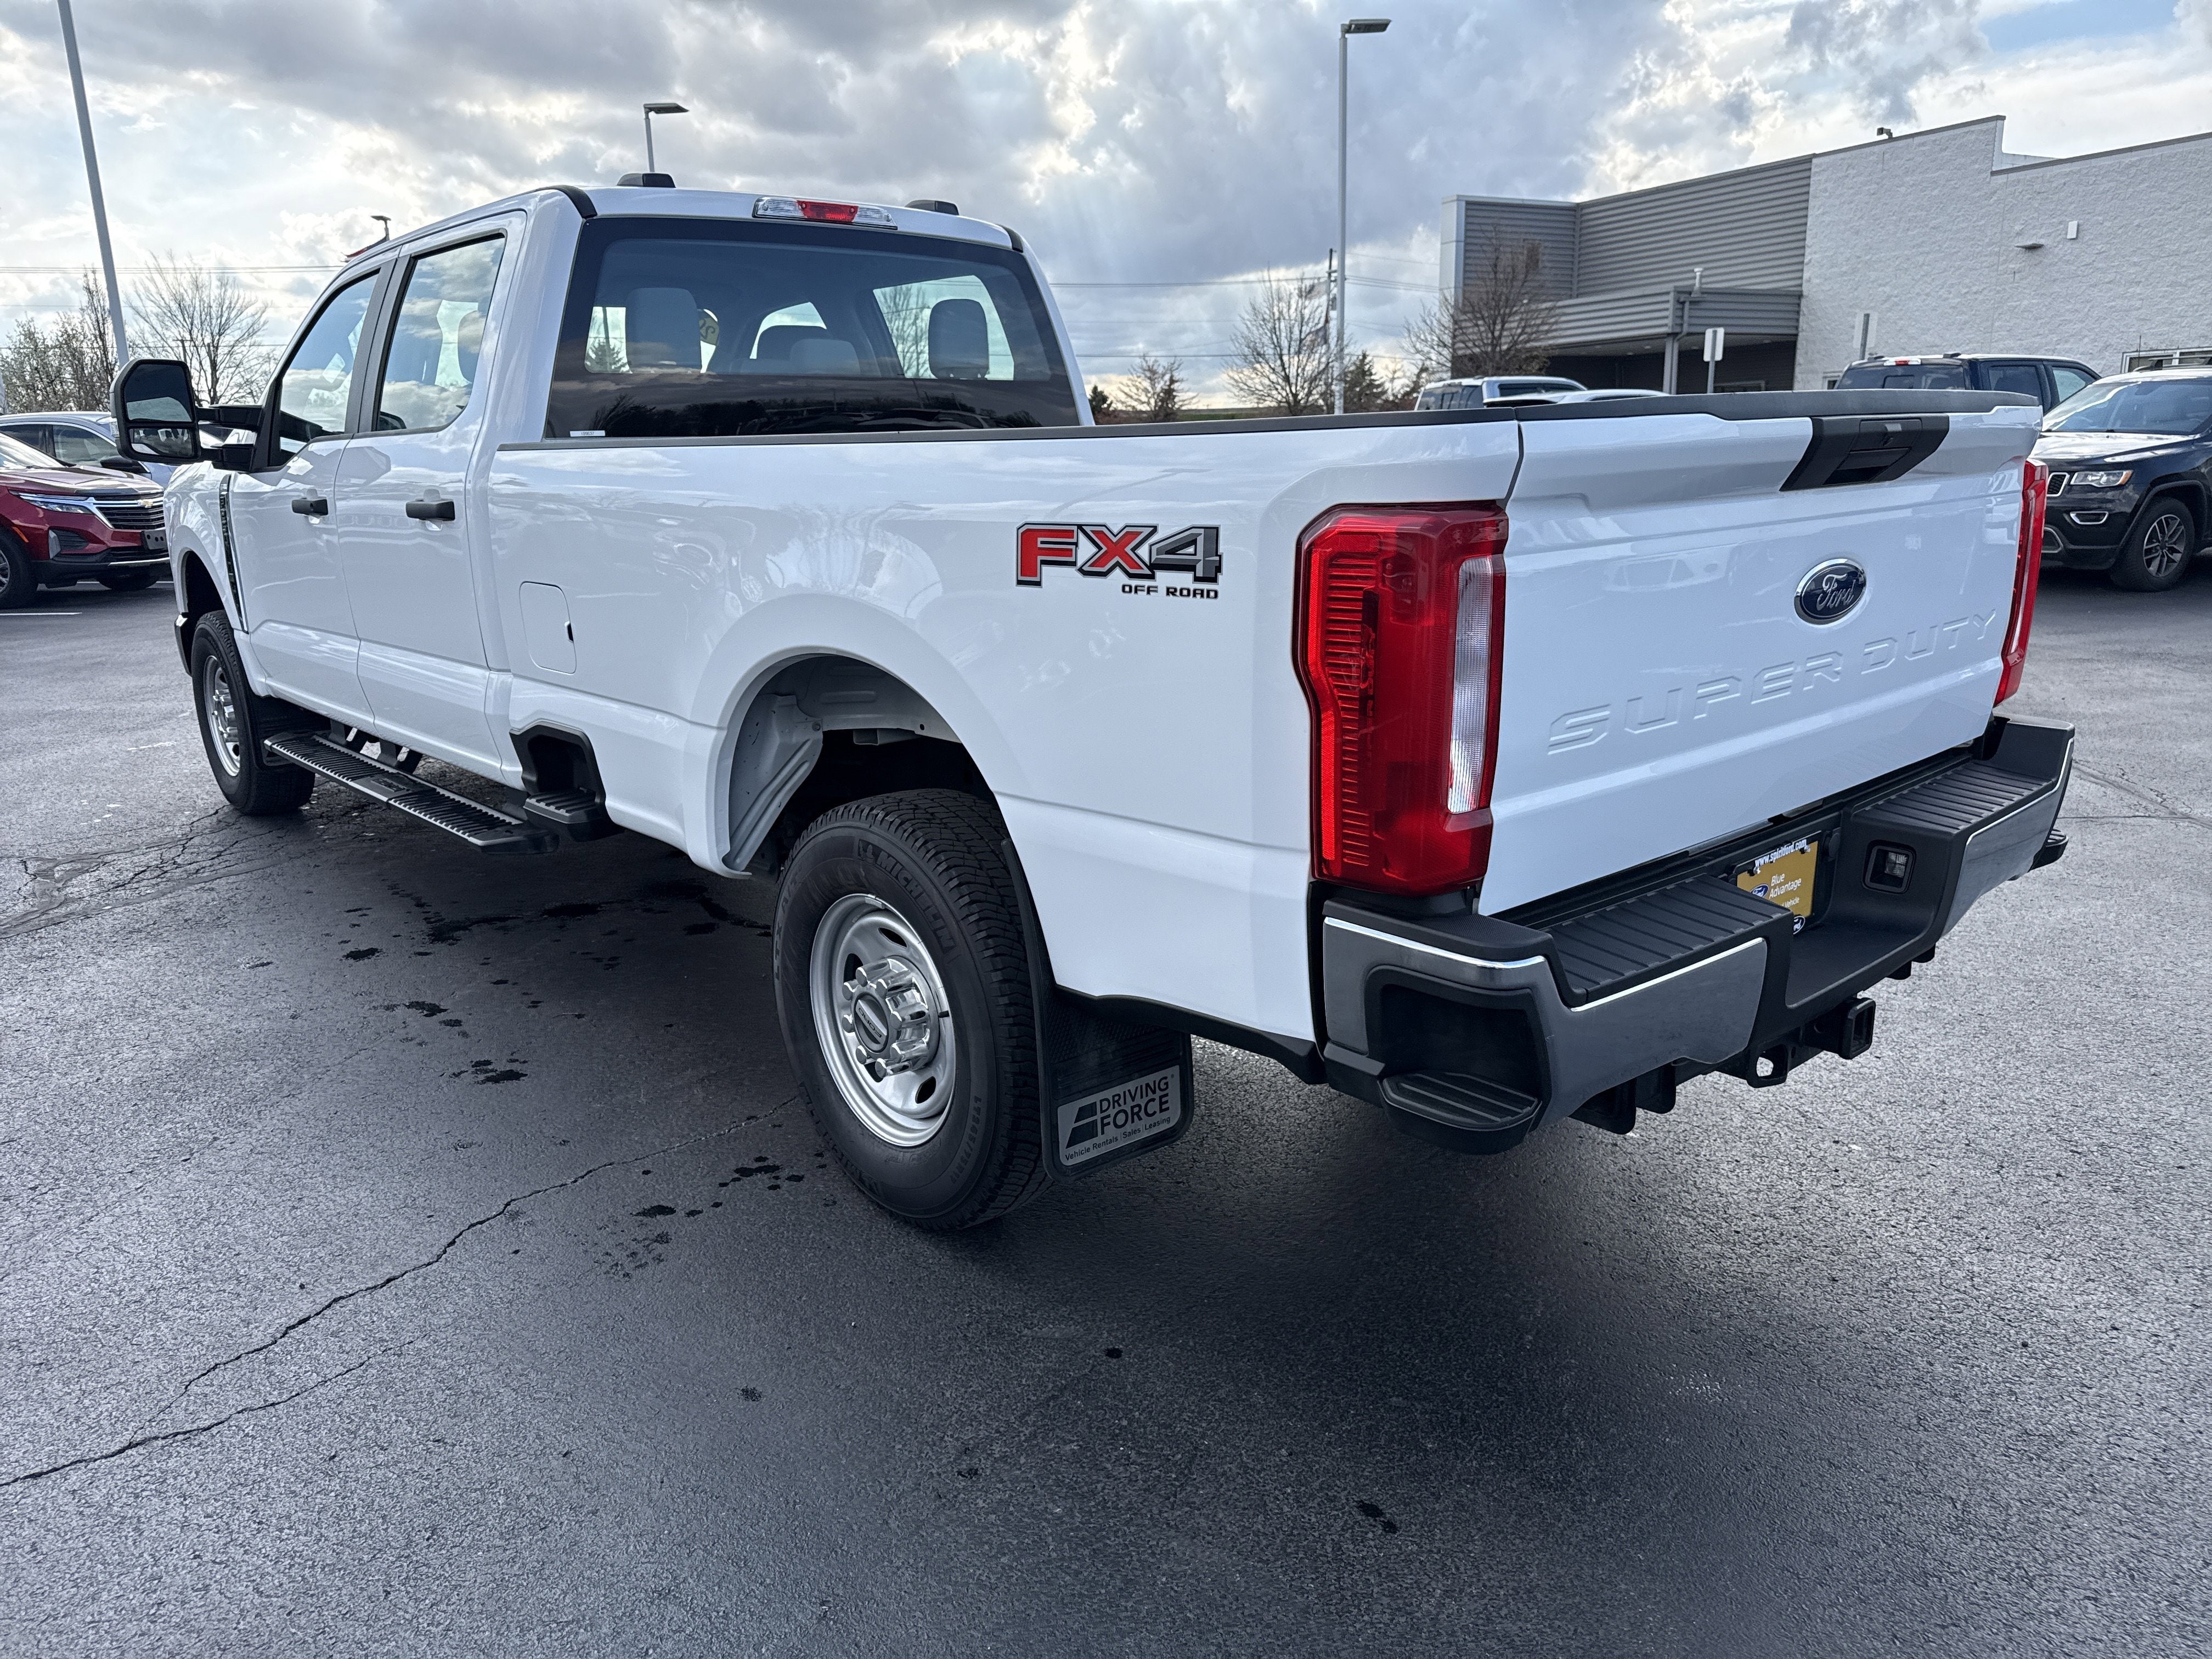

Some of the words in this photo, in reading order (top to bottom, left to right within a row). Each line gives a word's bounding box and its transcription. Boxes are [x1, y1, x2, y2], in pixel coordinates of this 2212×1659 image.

[1016, 521, 1223, 588] FX4
[1121, 584, 1159, 596] OFF
[1165, 585, 1219, 600] ROAD
[1816, 573, 1857, 611] Ford
[1547, 650, 1843, 755] SUPER
[1860, 609, 1997, 675] DUTY
[1754, 839, 1807, 867] www.spiritford.com
[1769, 878, 1802, 899] Advantage
[1770, 873, 1785, 887] Blue
[877, 850, 956, 949] MICHELIN
[858, 1007, 882, 1038] FORD
[1099, 1076, 1169, 1114] DRIVING
[1100, 1092, 1170, 1136] FORCE
[1065, 1146, 1091, 1161] Vehicle
[1092, 1136, 1119, 1150] Rentals
[1122, 1127, 1141, 1139] Sales
[1144, 1116, 1171, 1131] Leasing
